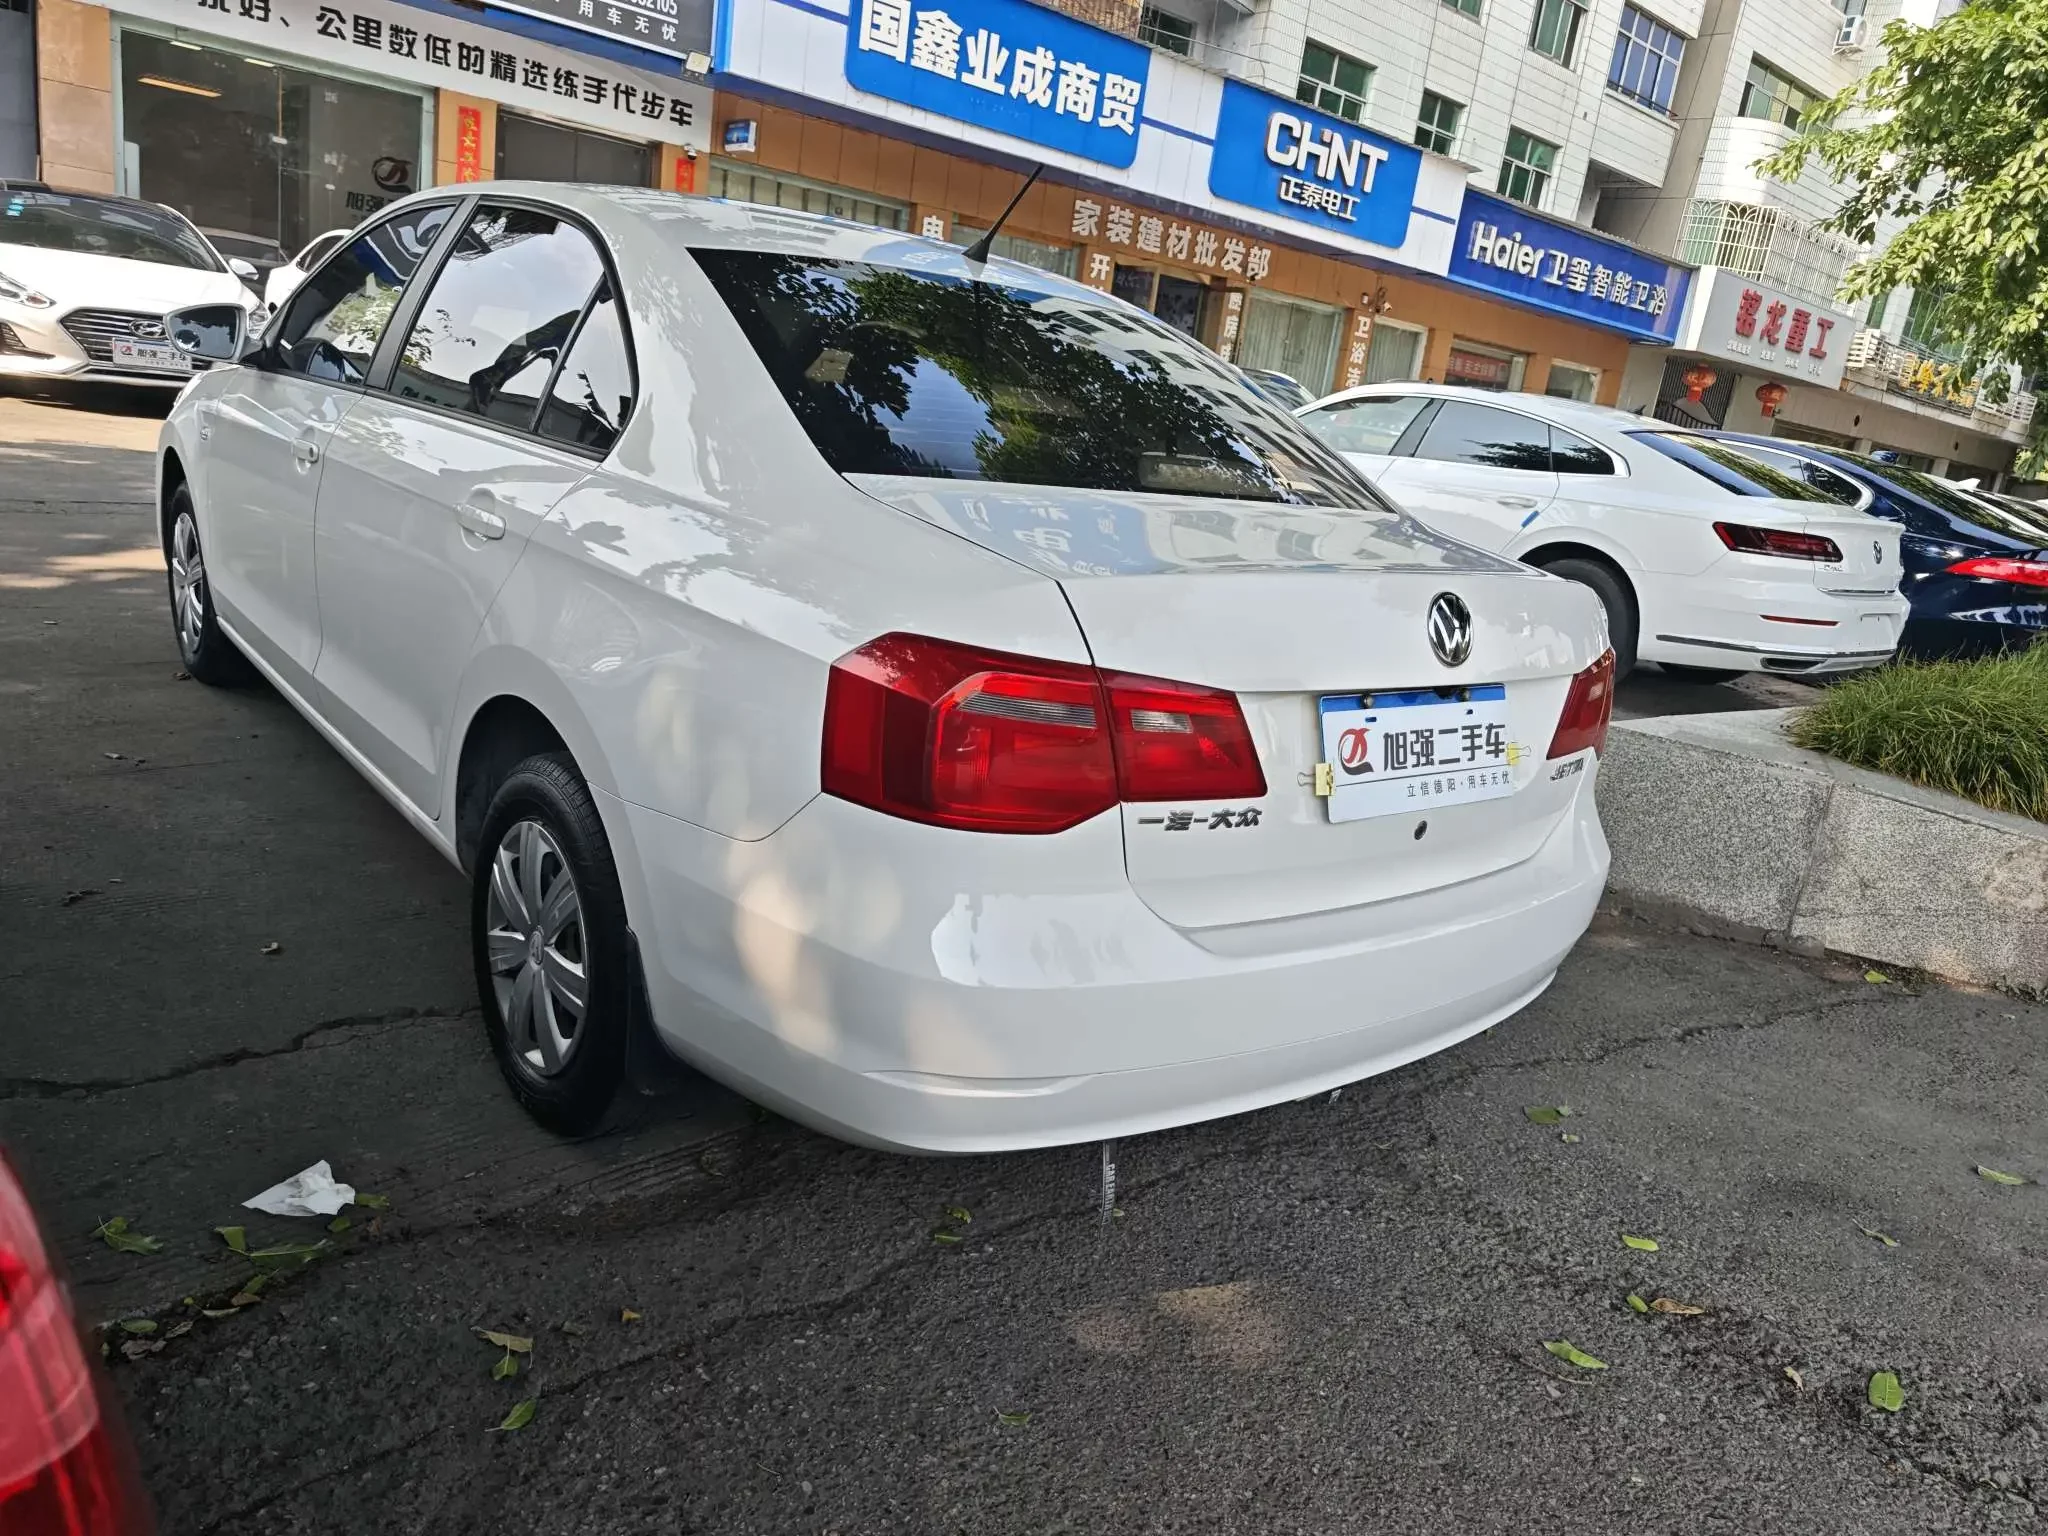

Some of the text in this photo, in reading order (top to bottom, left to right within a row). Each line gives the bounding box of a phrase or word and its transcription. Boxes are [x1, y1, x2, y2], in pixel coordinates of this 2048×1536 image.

[859, 0, 1142, 136] 国鑫业成商贸
[1280, 174, 1361, 221] 正泰电工
[1072, 199, 1273, 281] 家装建材批发部
[1383, 723, 1506, 772] 旭强二手车
